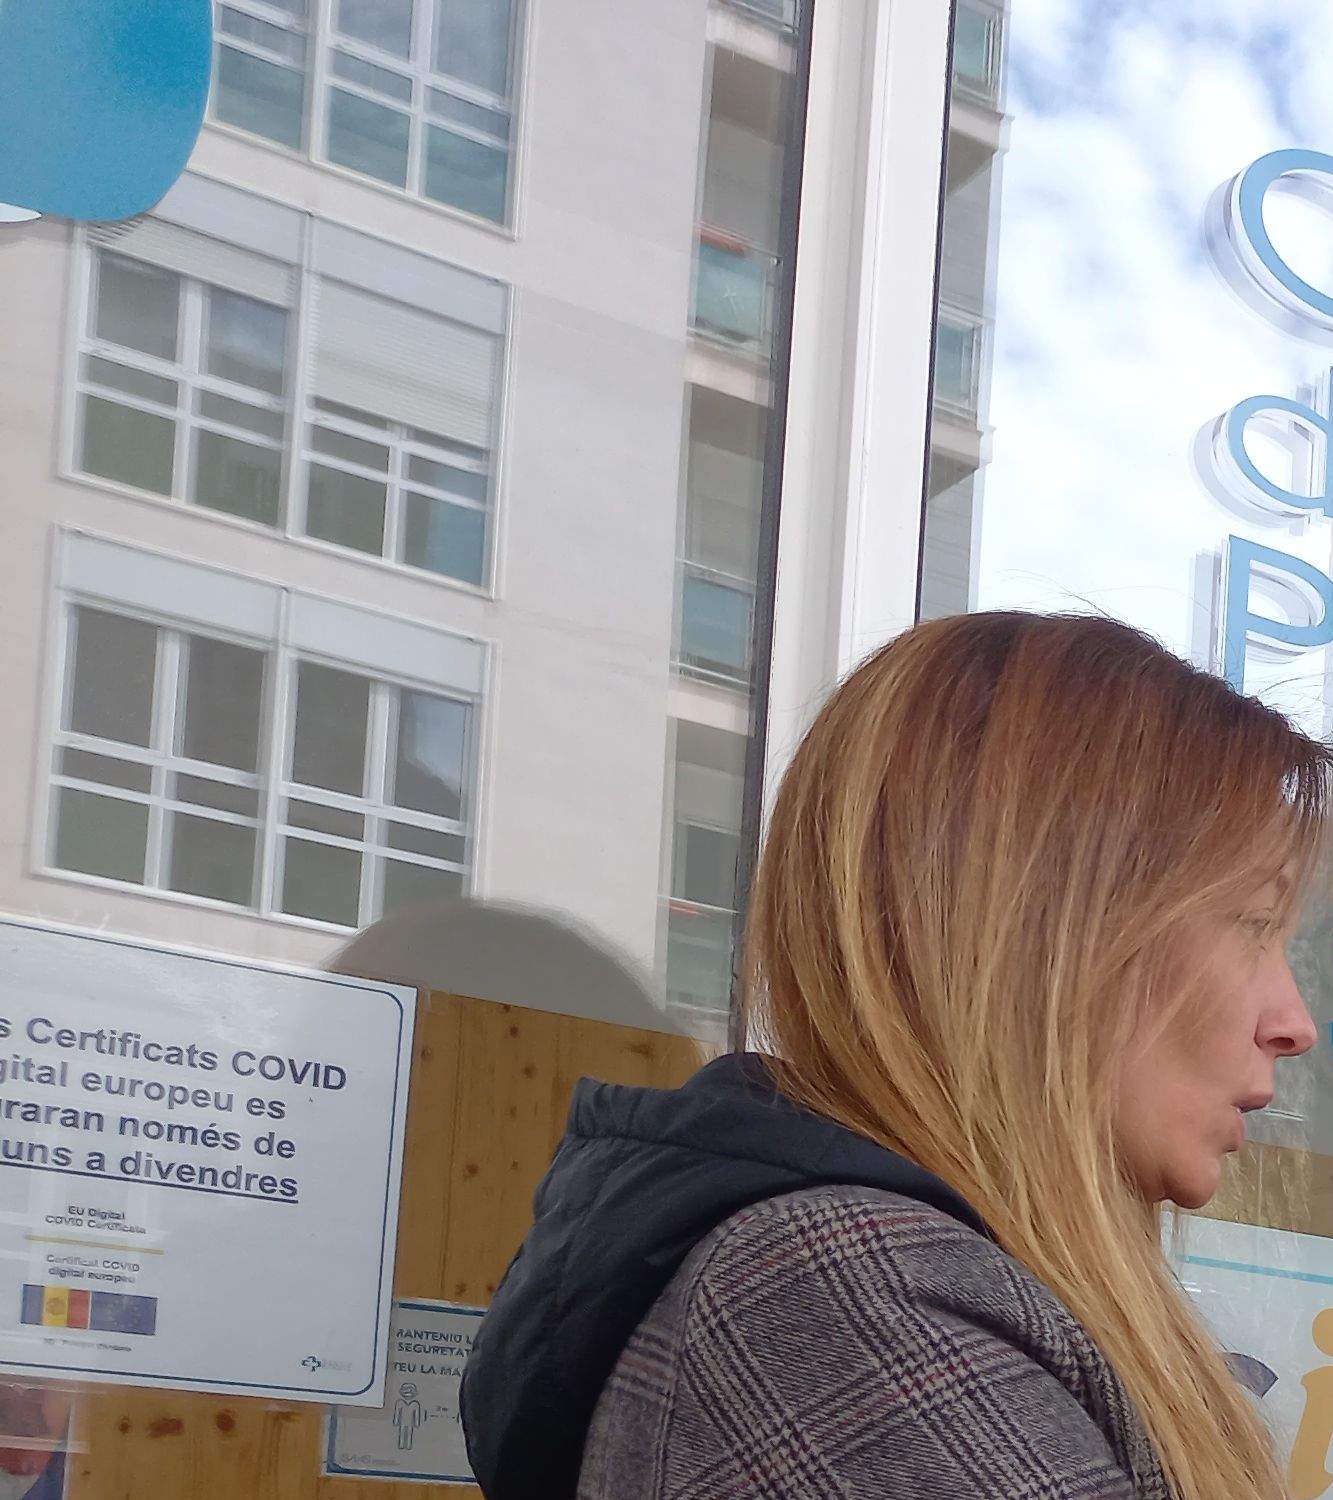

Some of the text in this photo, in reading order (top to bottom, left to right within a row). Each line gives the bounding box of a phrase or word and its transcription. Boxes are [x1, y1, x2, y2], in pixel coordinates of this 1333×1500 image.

[26, 1016, 218, 1071] Certificats
[231, 1050, 348, 1091] COVID
[81, 1070, 234, 1112] europeu
[246, 1096, 287, 1120] es
[0, 1098, 297, 1160] raran només de
[86, 1150, 106, 1172] a
[120, 1150, 299, 1198] divendres
